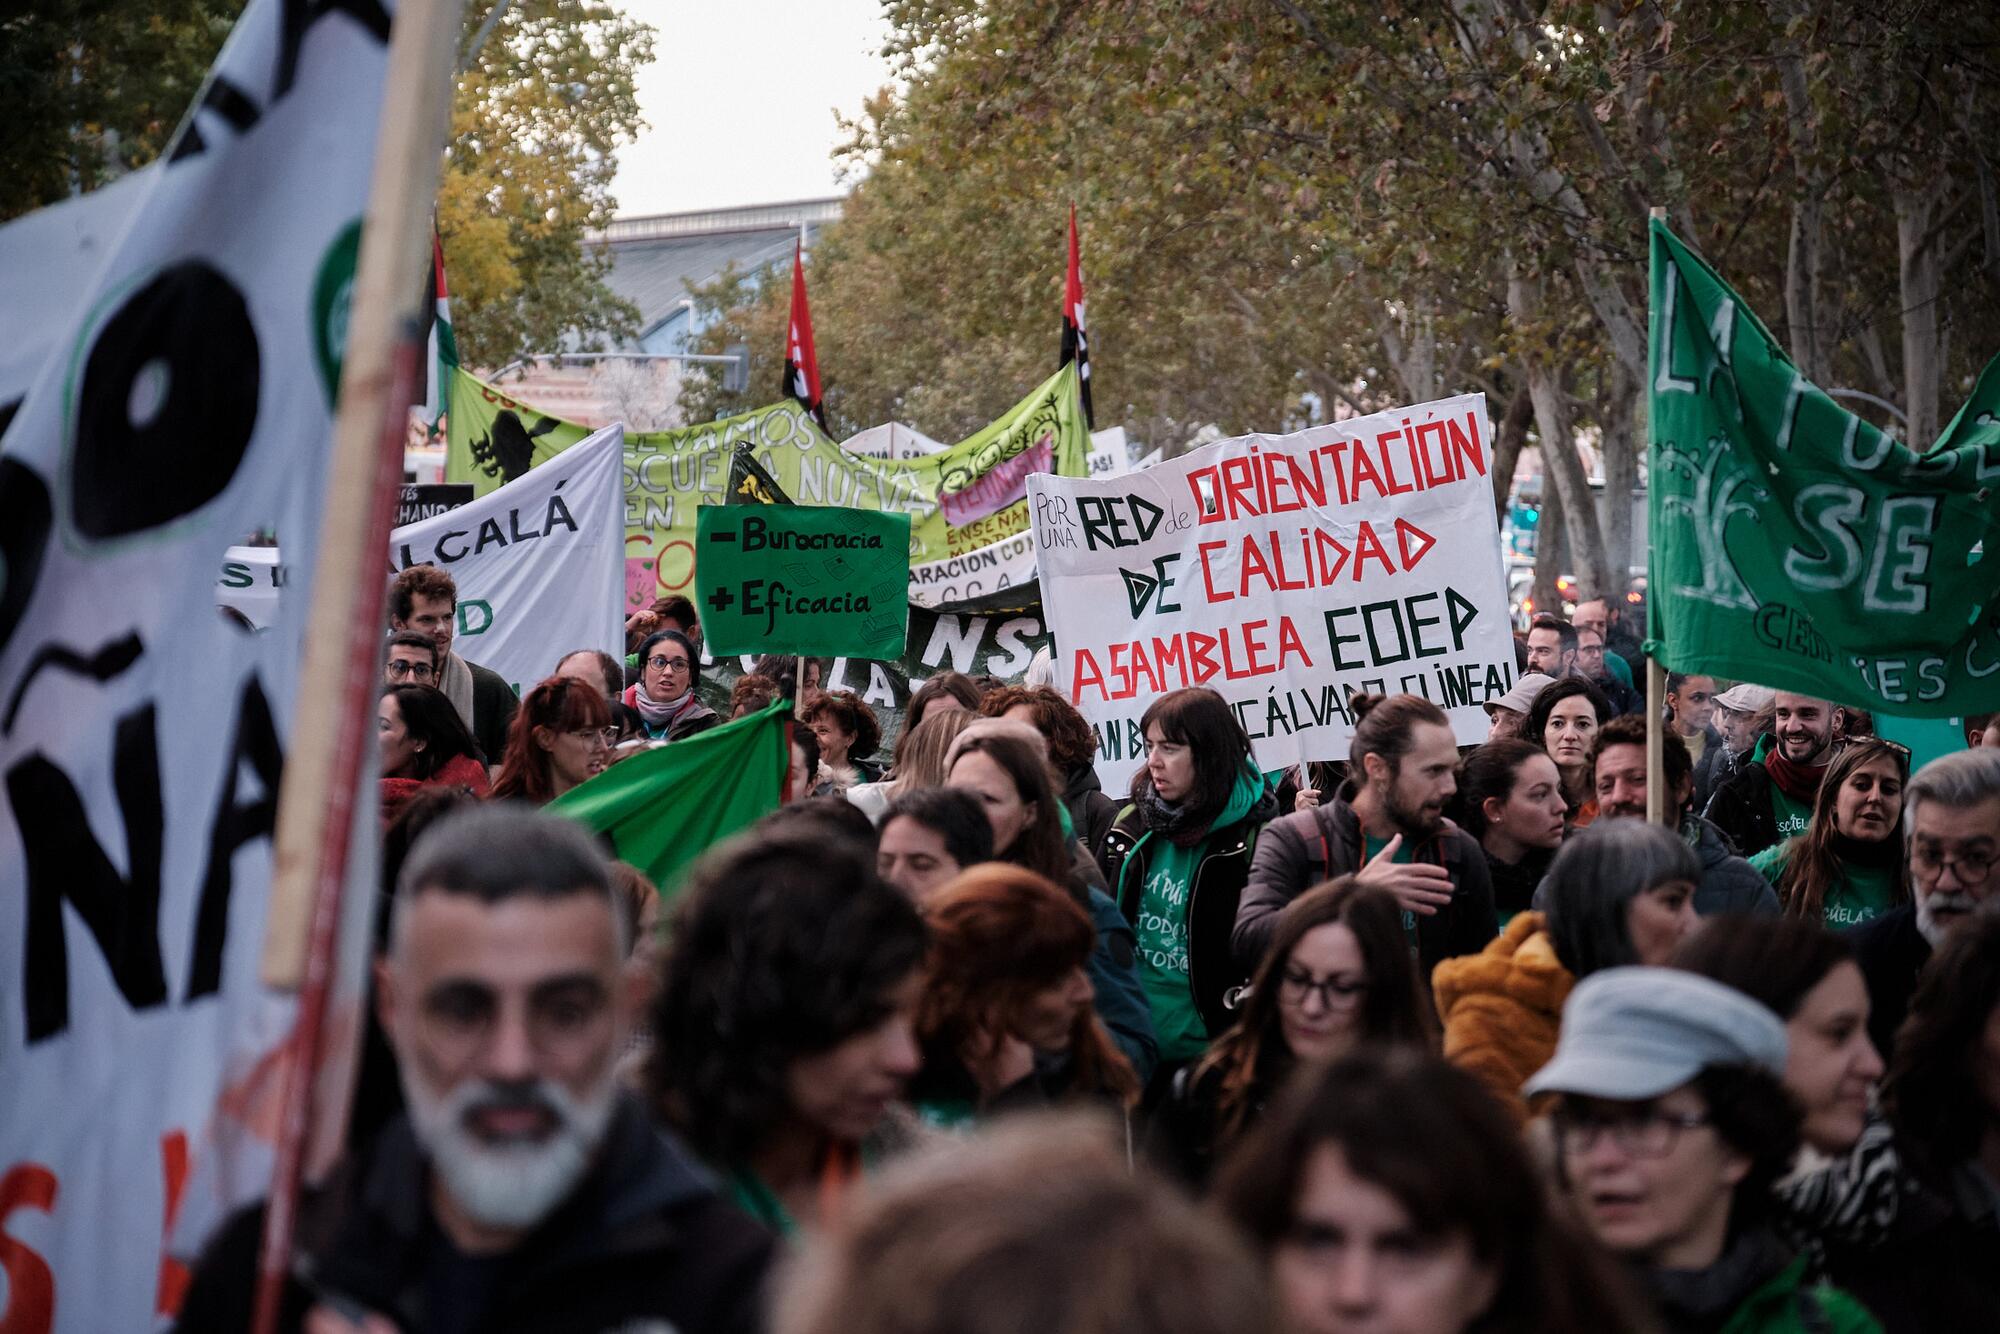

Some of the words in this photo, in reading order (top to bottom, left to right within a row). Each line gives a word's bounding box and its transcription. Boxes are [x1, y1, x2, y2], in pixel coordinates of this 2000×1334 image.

[390, 480, 579, 574] LCALÁ
[742, 516, 884, 553] Burocracia
[1035, 491, 1077, 529] POR
[1039, 521, 1078, 551] UNA
[1075, 493, 1165, 551] RED
[1164, 509, 1192, 536] de
[1784, 483, 1943, 613] SE
[741, 579, 872, 637] Eficacia
[1118, 552, 1182, 620] DE
[1071, 615, 1313, 707] ASAMBLEA
[1323, 586, 1480, 672] EOEP
